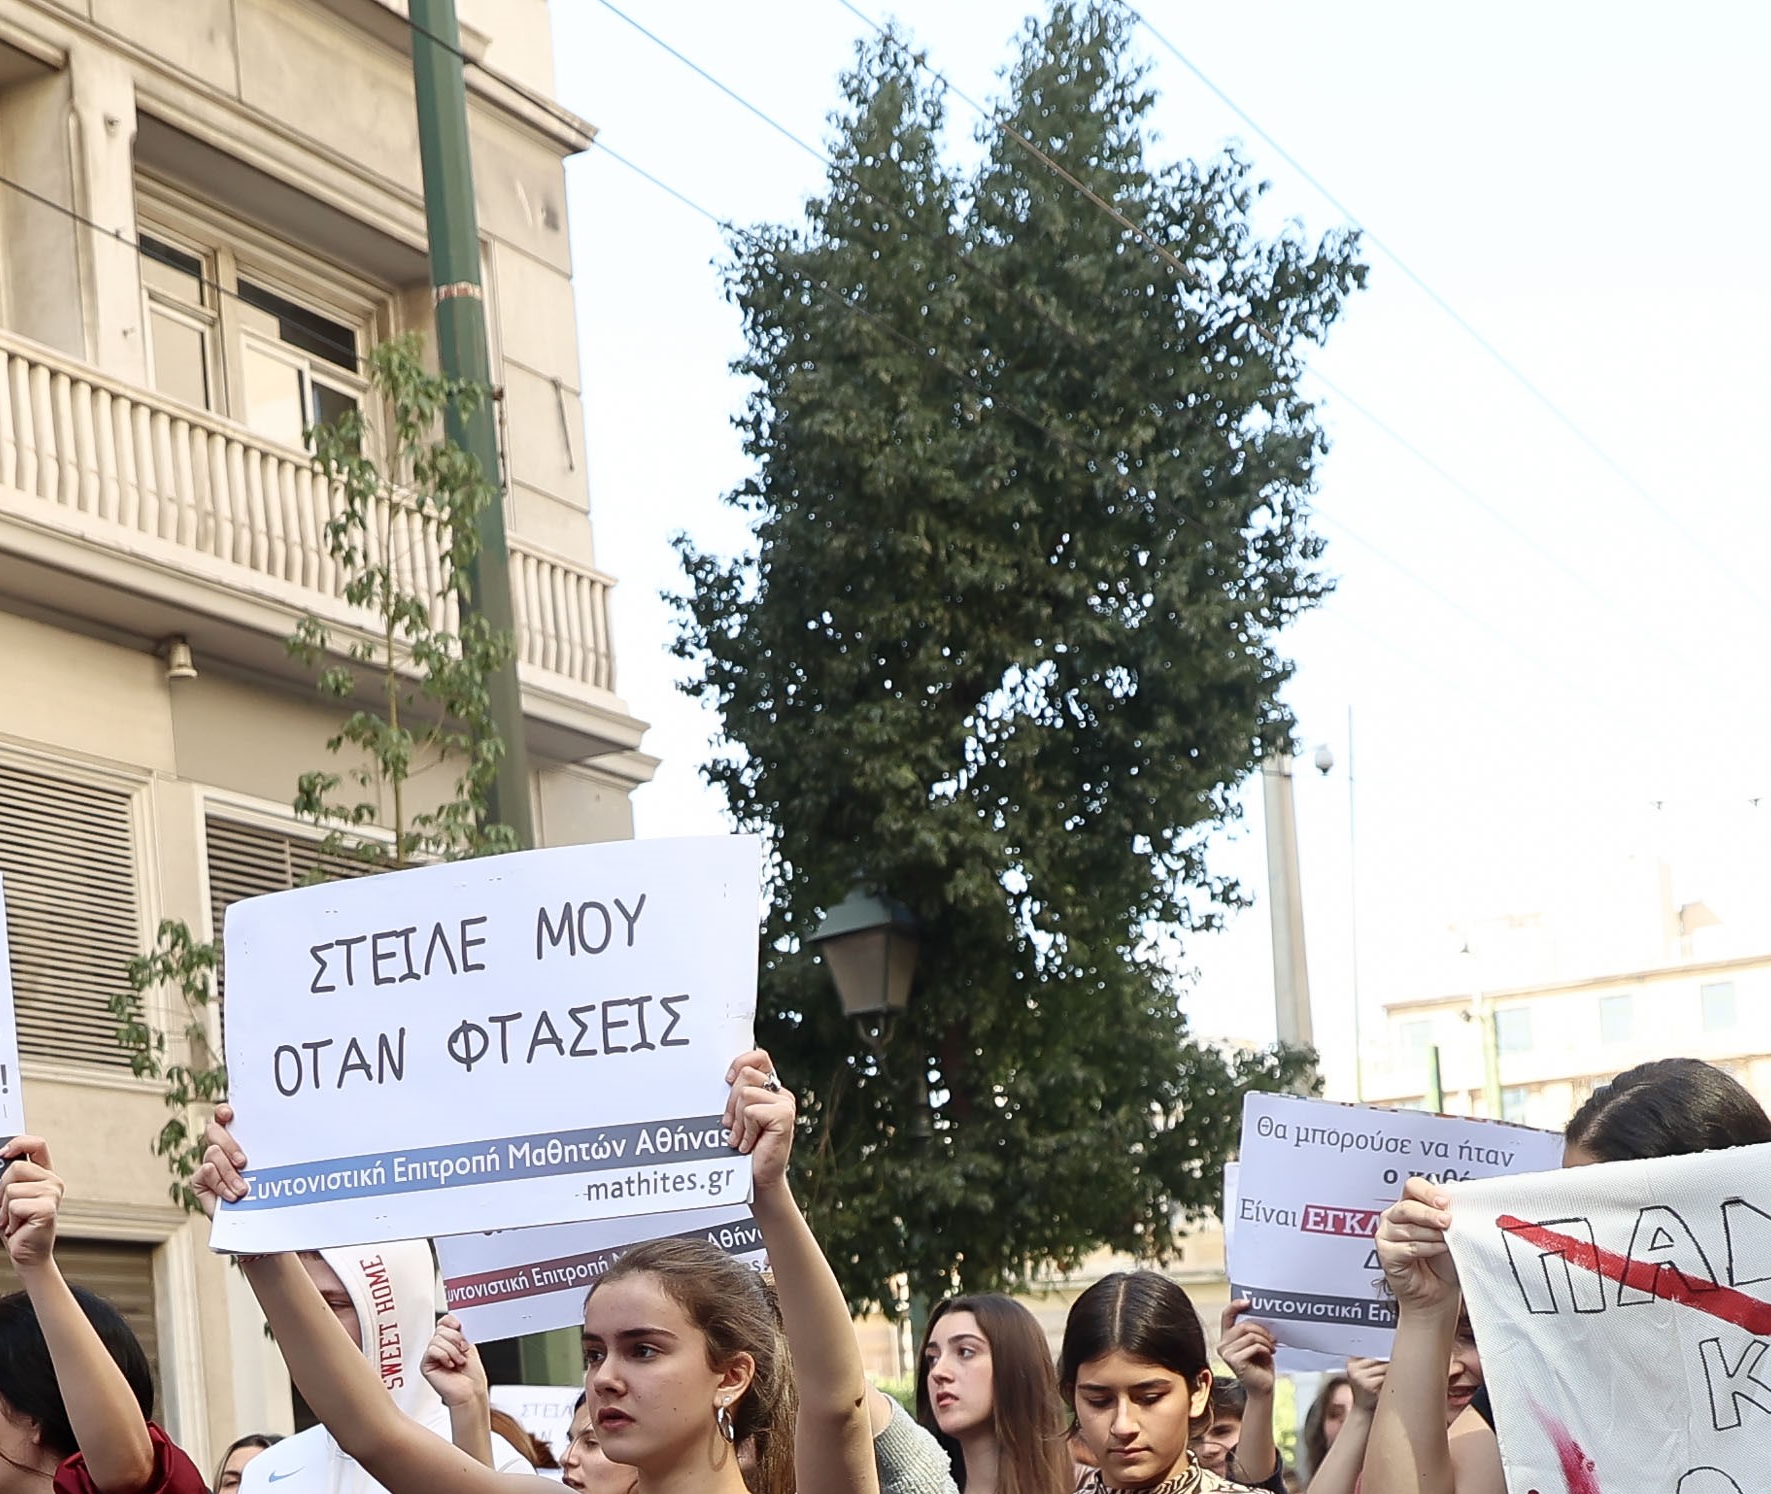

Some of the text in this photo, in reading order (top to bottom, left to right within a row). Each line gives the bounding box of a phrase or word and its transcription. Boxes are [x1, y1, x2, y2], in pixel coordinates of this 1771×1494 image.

[309, 893, 647, 994] ΣΤΕΙΛΕ ΜΟΥ
[273, 994, 691, 1097] ΟΤΑΝ ΦΤΑΣΕΙΣ
[243, 1124, 731, 1201] Συντονιστική Επιτροπή Μαθητών Αθήνας
[1257, 1116, 1515, 1168] Θα μπορούσε να ήταν
[587, 1167, 735, 1202] mathites.gr
[1240, 1198, 1297, 1228] Είναι
[533, 1256, 609, 1288] Επιτροπή
[359, 1254, 405, 1391] SWEET HOME
